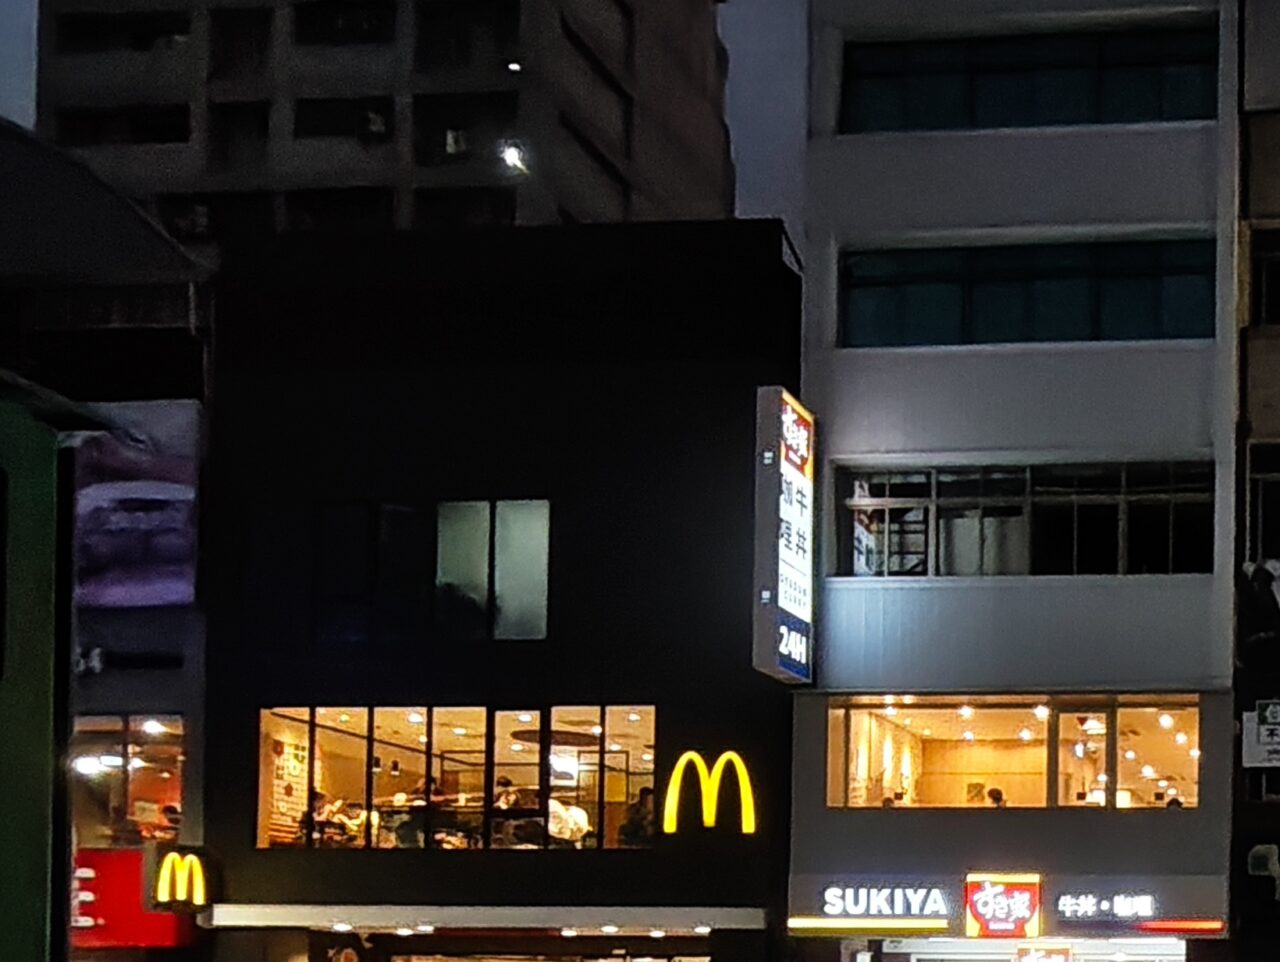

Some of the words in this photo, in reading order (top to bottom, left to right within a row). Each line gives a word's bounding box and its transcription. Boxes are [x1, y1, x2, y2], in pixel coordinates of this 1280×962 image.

[779, 625, 807, 664] 24H
[823, 888, 948, 915] SUKIYA
[973, 881, 1031, 922] すき家
